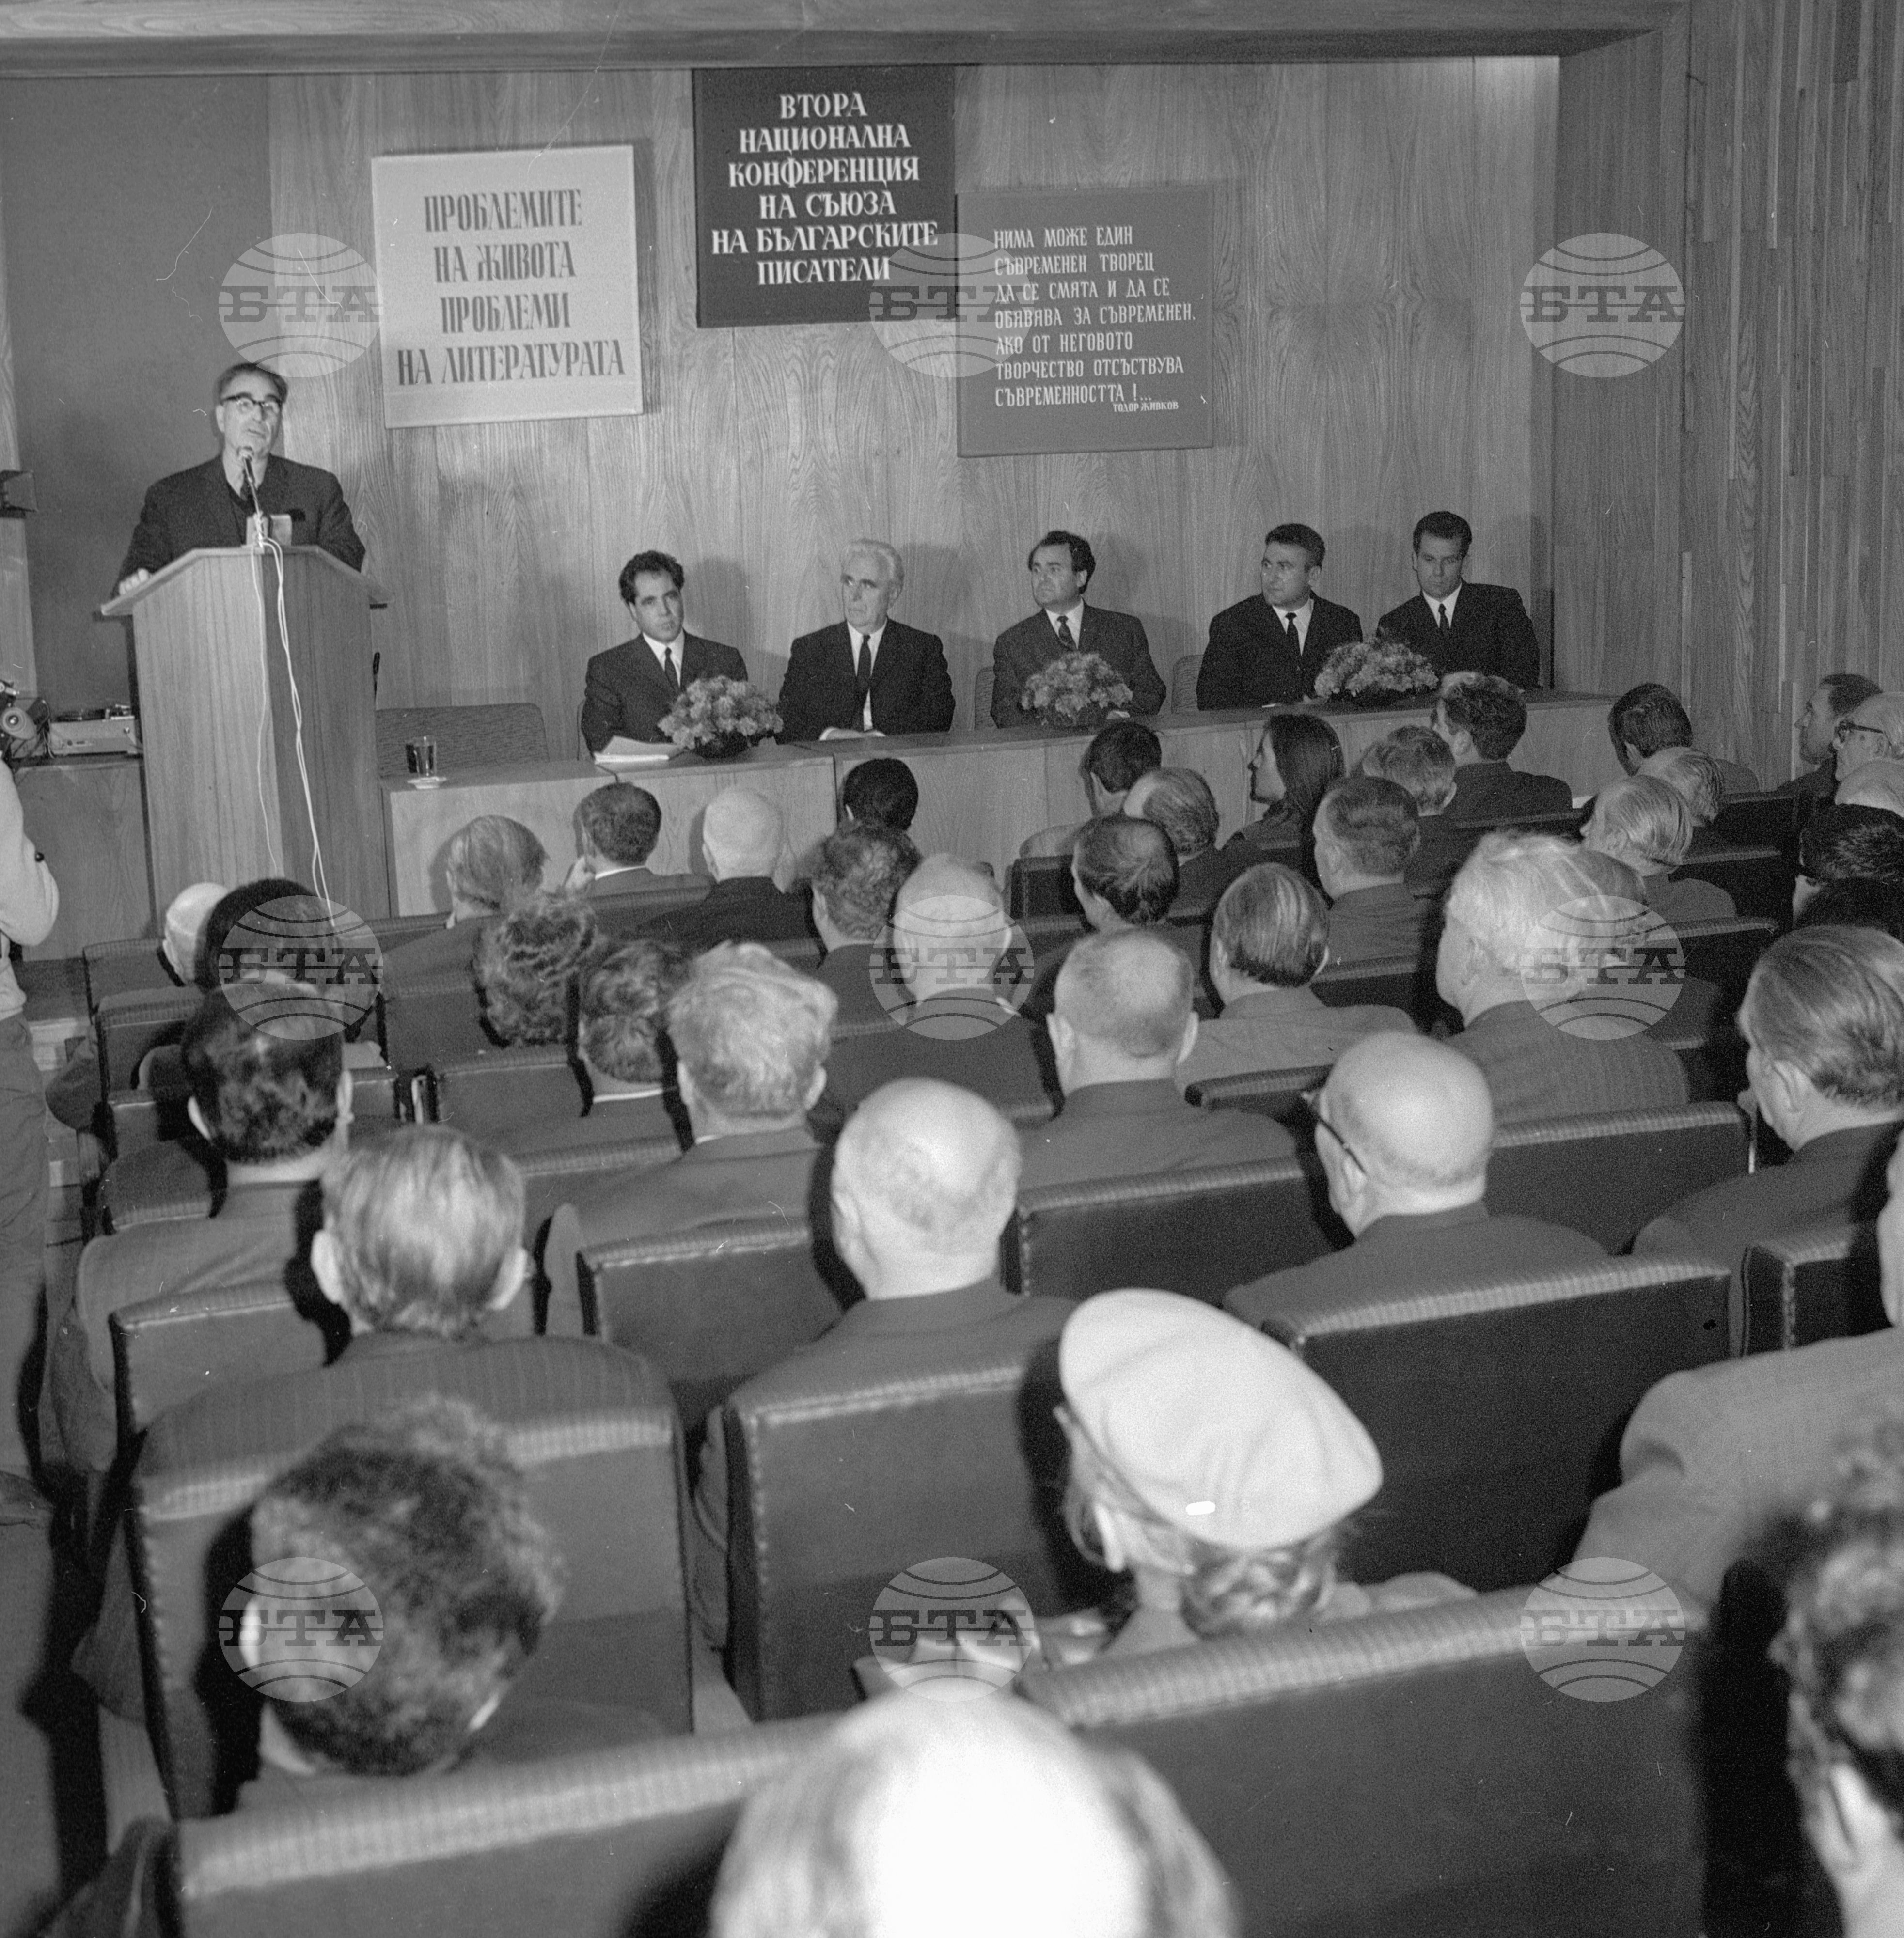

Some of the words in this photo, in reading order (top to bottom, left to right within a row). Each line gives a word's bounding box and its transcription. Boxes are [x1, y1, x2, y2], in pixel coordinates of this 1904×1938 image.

[780, 92, 867, 119] ВТОРА
[740, 123, 911, 155] НАЦИОНАЛНА
[728, 156, 920, 188] КОНФЕРЕНЦИЯ
[424, 189, 582, 233] ПРОБЛЕМИТЕ
[759, 193, 797, 219] НА
[805, 189, 897, 218] СЪЮЗА
[711, 228, 749, 254] НА
[756, 221, 938, 252] БЪЛГАРСКИТЕ
[994, 228, 1035, 250] НИМА
[1044, 227, 1088, 248] МОЖЕ
[1096, 225, 1133, 247] ЕДИН
[434, 246, 469, 283] НА
[477, 241, 577, 281] ЖИВОТА
[757, 256, 890, 285] ПИСАТЕЛИ
[995, 254, 1087, 276] СЪВРЕМЕНЕН
[1100, 252, 1155, 272] ТВОРЕЦ
[995, 283, 1015, 303] ДА
[1023, 282, 1039, 301] СЕ
[1049, 281, 1099, 300] СМЯТА
[1108, 280, 1117, 298] И
[1126, 279, 1147, 298] ДА
[1153, 277, 1170, 297] СЕ
[440, 292, 571, 333] ПРОБЛЕМИ
[995, 307, 1063, 329] ОБЯВЯВА
[1073, 306, 1092, 326] ЗА
[996, 335, 1023, 356] АКО
[1032, 334, 1050, 354] ОТ
[1060, 331, 1133, 353] НЕГОВОТО
[397, 348, 433, 386] НА
[441, 340, 626, 384] ЛИТЕРАТУРАТА
[996, 360, 1084, 381] ТВОРЧЕСТВО
[1093, 356, 1184, 376] ОТСЪСТВУВА
[995, 384, 1125, 407] СЪВРЕМЕННОСТТА
[1113, 403, 1139, 412] ТОДОР
[1140, 401, 1179, 411] ЖИВКОВ
